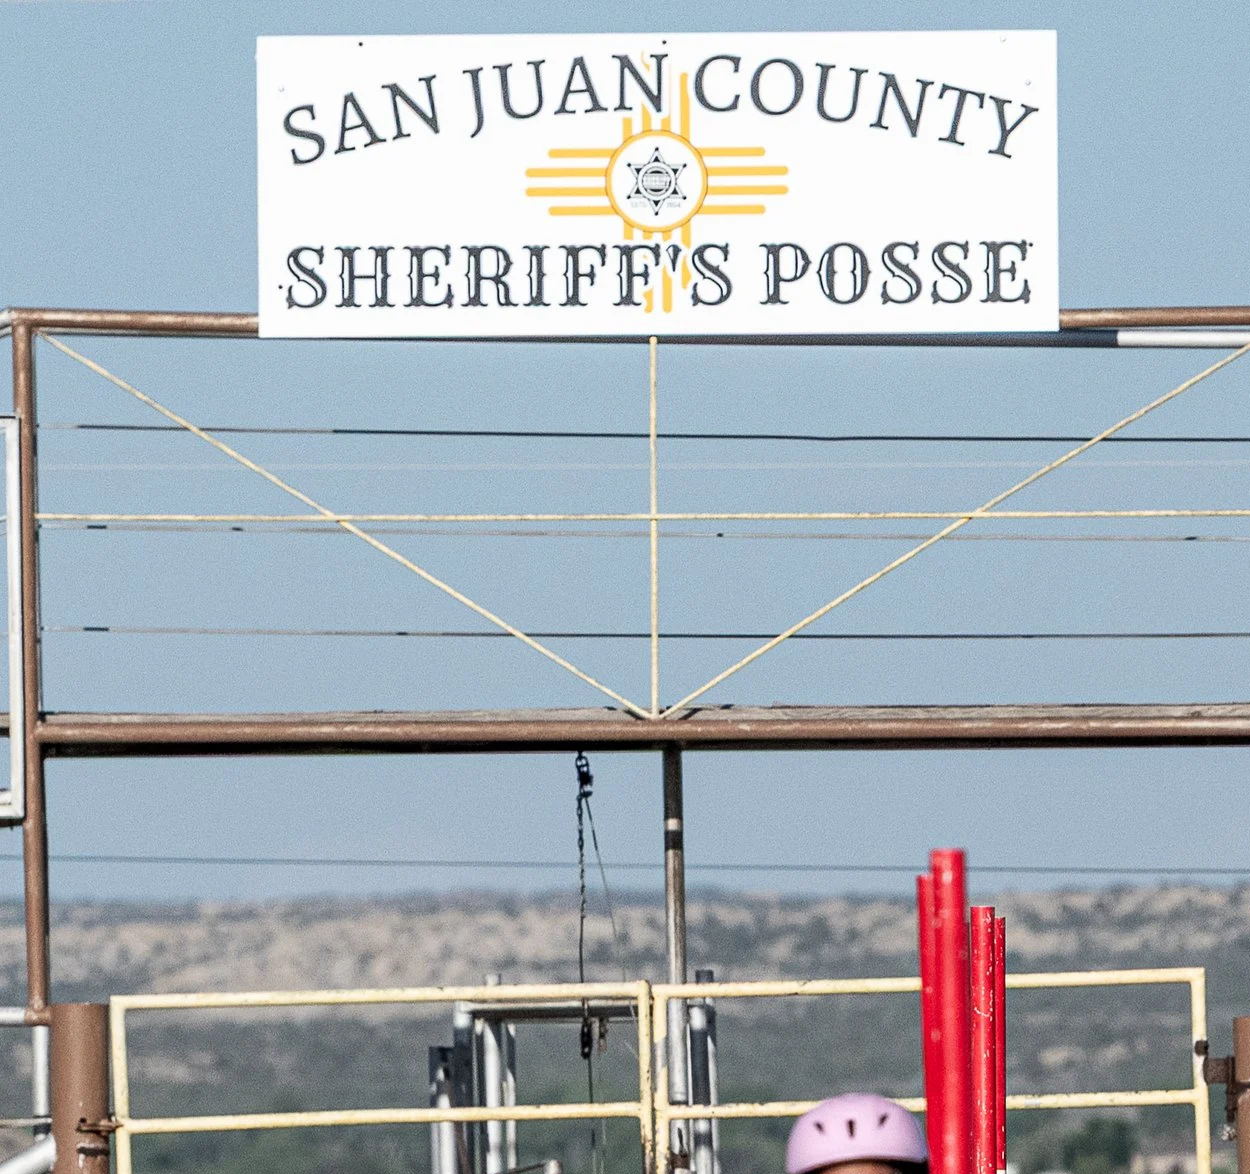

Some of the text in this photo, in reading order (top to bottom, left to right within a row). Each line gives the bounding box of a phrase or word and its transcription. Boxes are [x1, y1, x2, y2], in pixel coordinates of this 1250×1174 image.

[283, 53, 1041, 165] SAN JUAN COUNTY
[285, 239, 1033, 310] SHERIFF'S POSSE
